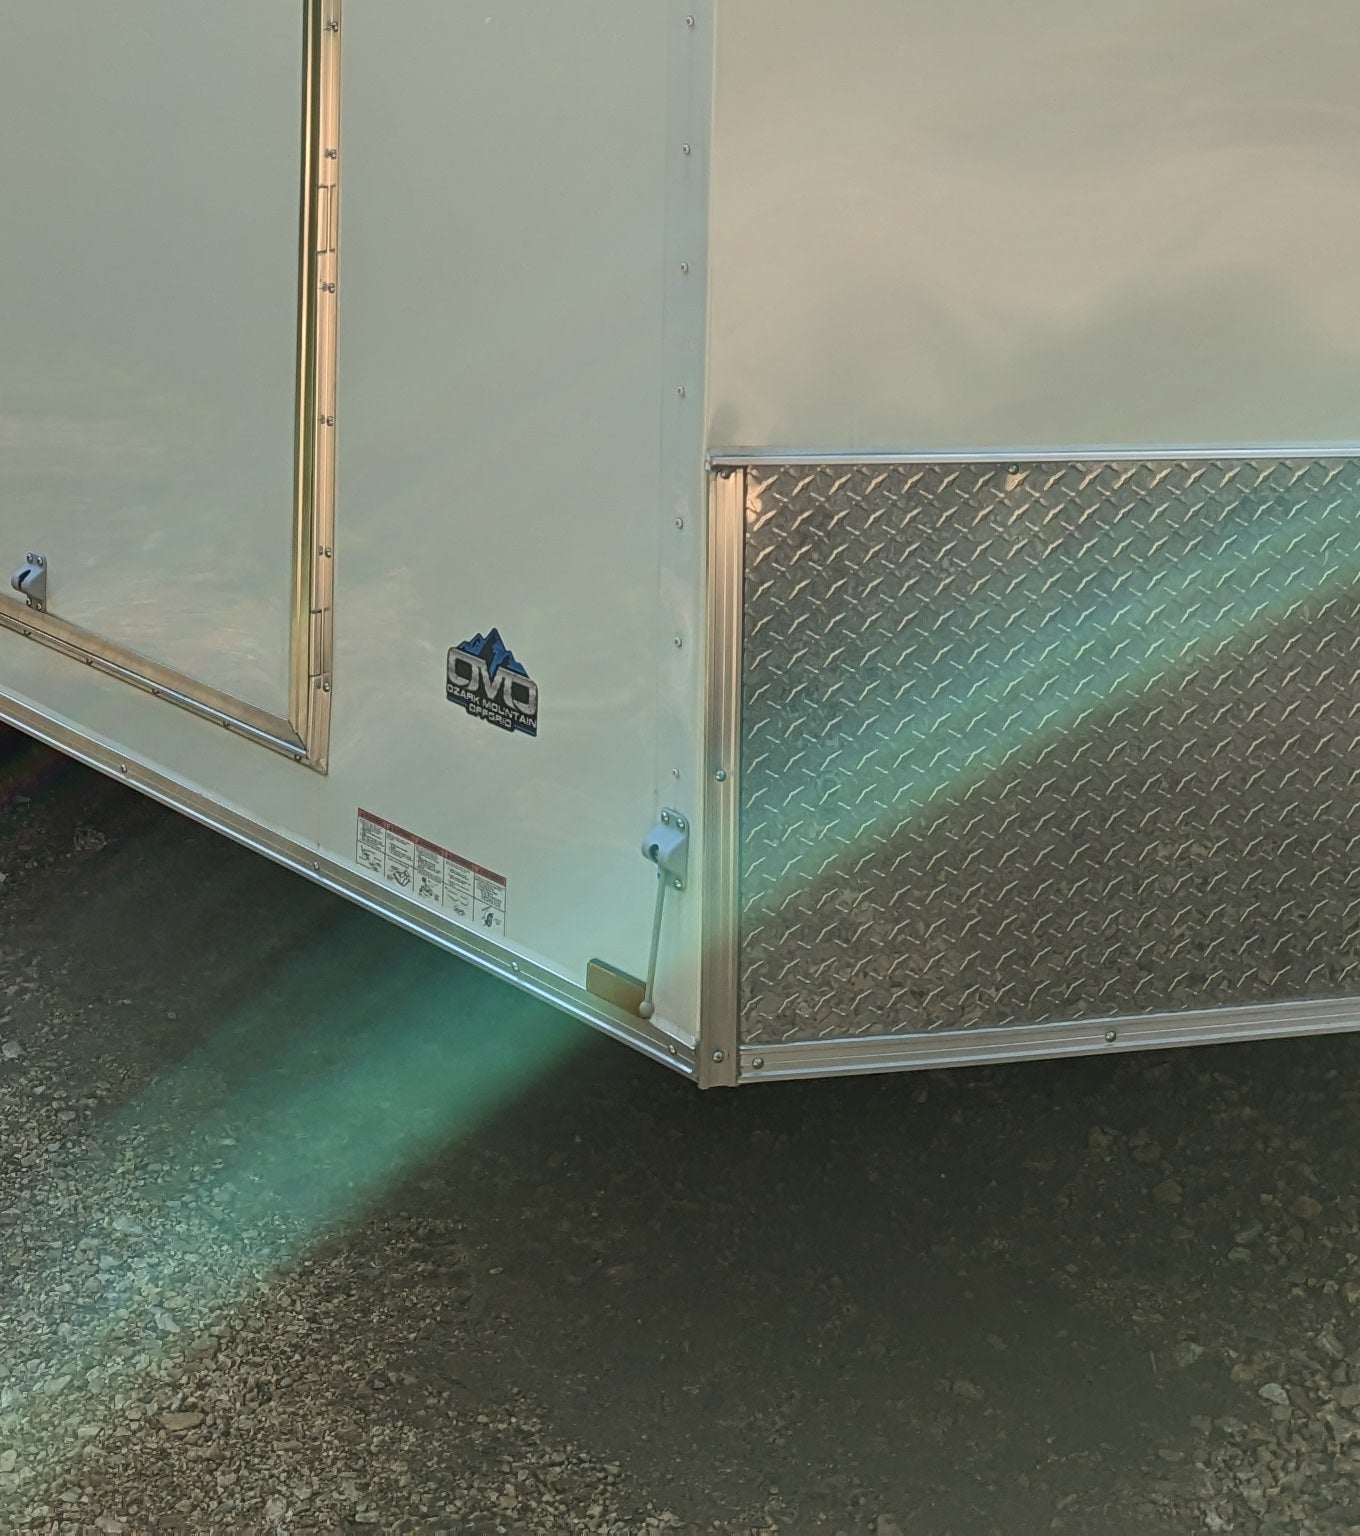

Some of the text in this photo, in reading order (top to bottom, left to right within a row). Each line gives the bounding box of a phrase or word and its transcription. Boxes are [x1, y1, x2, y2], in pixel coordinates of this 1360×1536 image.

[447, 684, 537, 728] OZARK MOUNTAIN
[469, 703, 512, 728] OFFGRID
